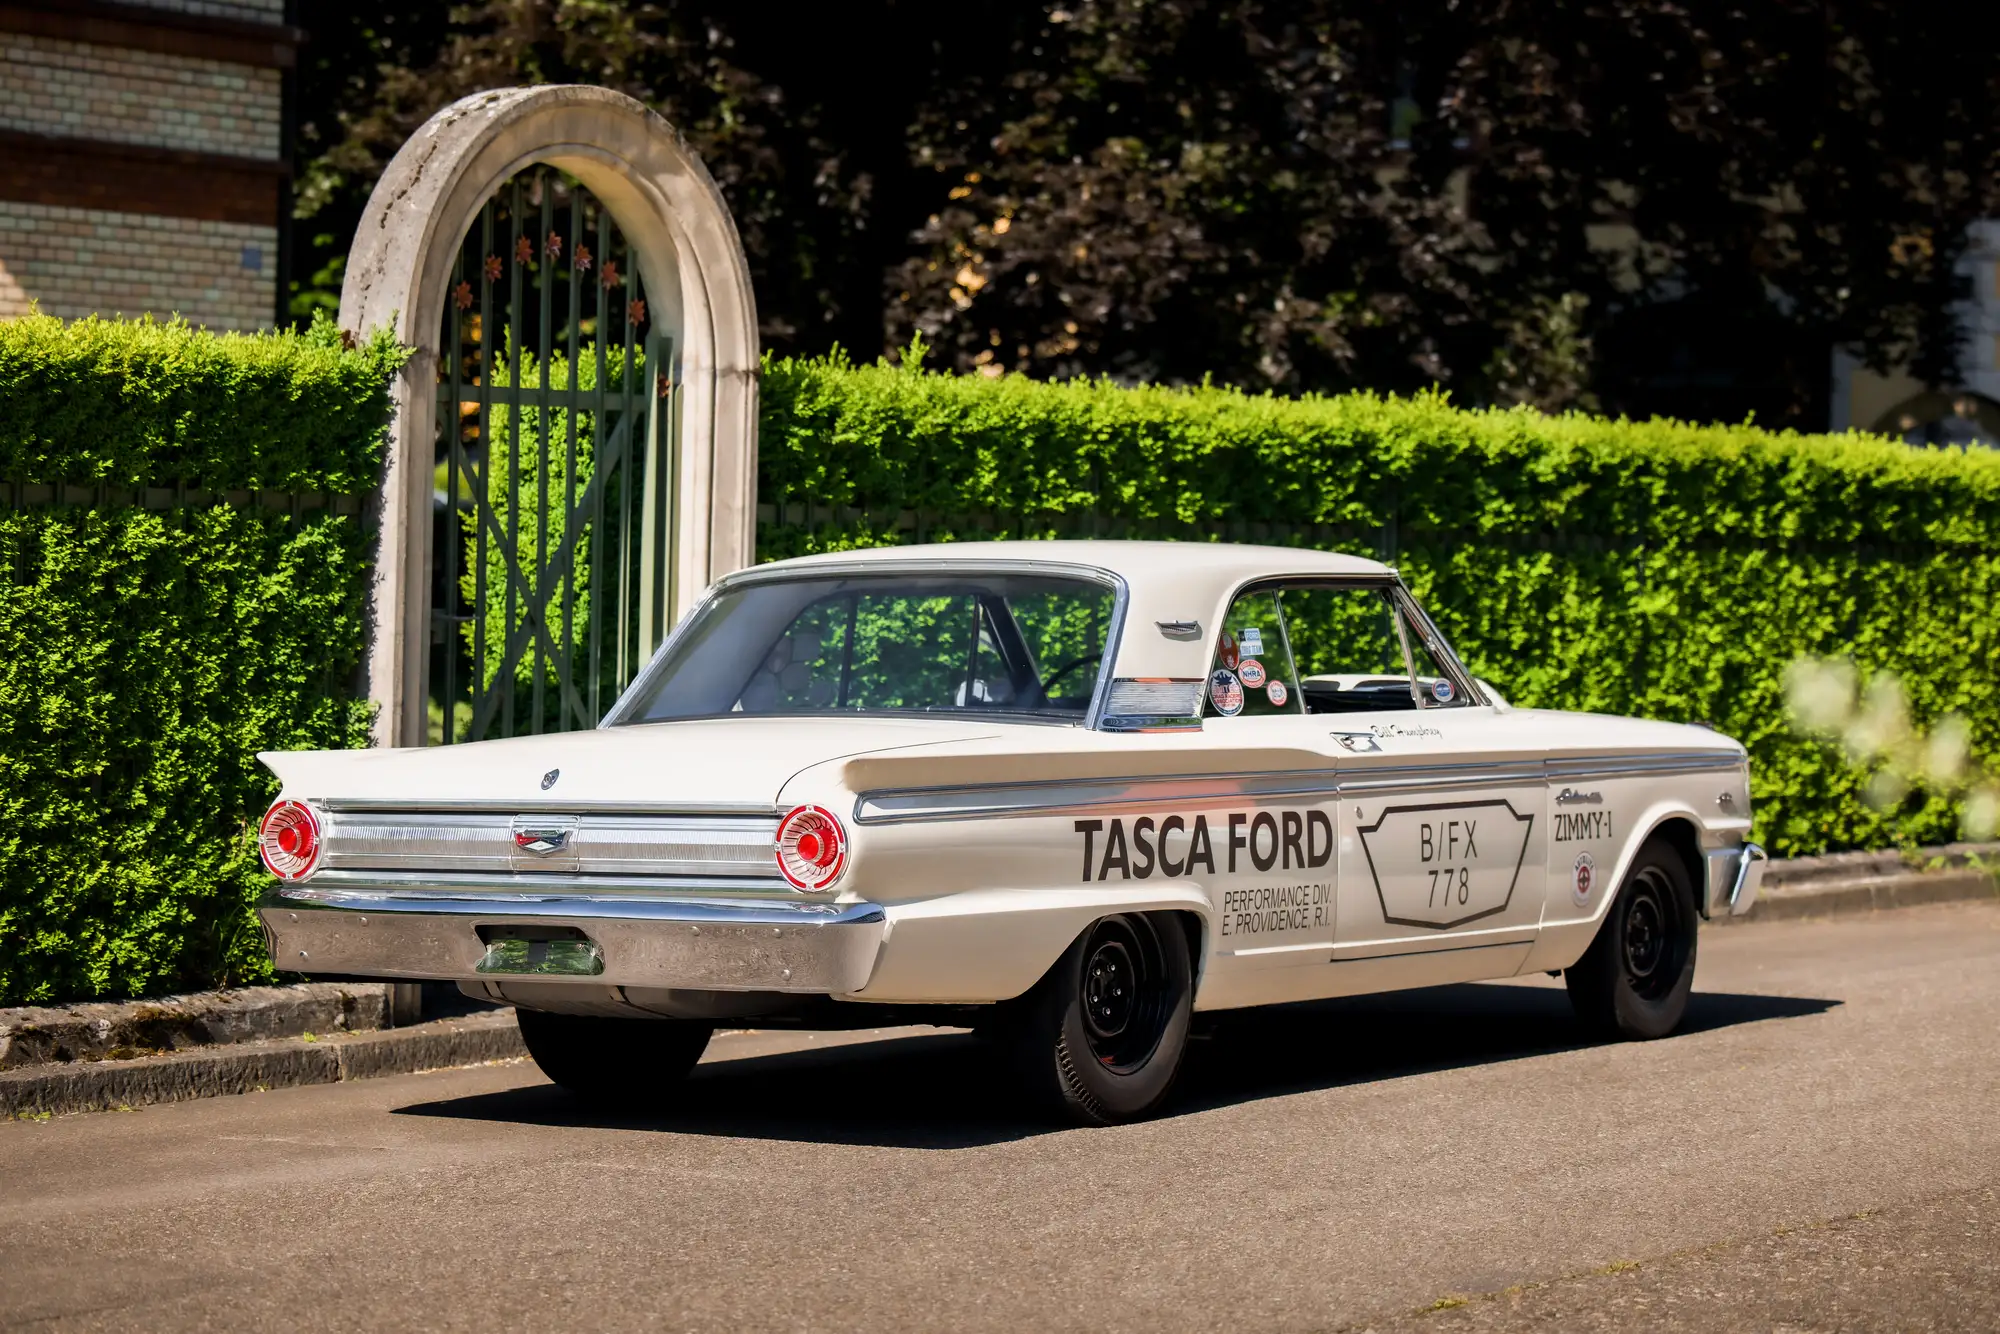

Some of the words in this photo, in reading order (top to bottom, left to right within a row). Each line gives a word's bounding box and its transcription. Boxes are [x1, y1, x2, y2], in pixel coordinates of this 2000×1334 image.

[1242, 670, 1260, 678] NHRA
[1074, 815, 1216, 882] TASCA
[1228, 810, 1333, 873] FORD
[1420, 820, 1478, 863] B/FX
[1224, 885, 1310, 912] PERFORMANCE
[1312, 884, 1332, 905] DIV.
[1428, 867, 1469, 908] 778
[1221, 915, 1232, 936] E.
[1235, 908, 1311, 934] PROVIDENCE,
[1314, 906, 1330, 928] R.I.
